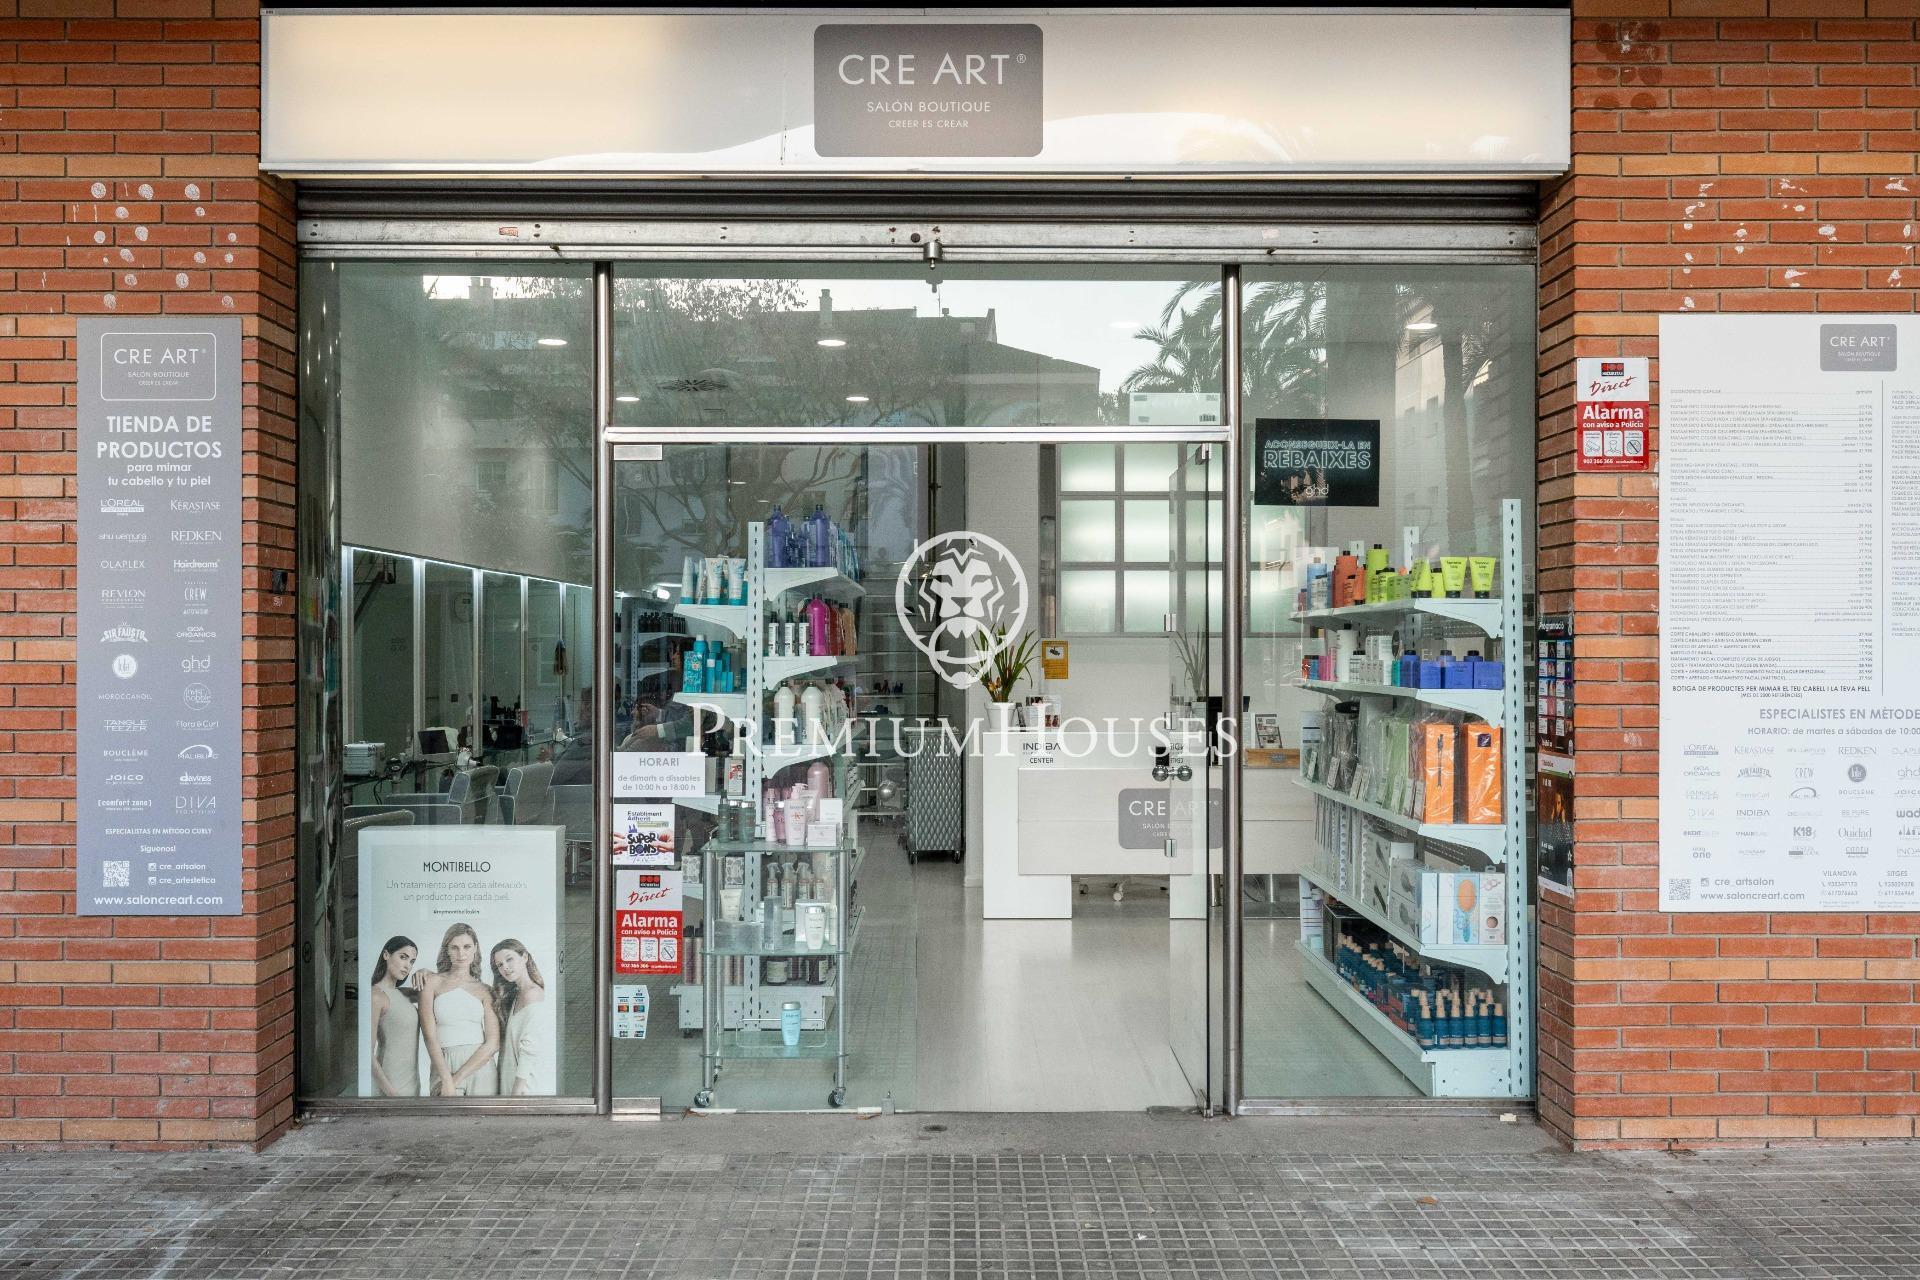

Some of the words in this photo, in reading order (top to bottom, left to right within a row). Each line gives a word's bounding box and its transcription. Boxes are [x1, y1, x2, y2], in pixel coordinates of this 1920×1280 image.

[838, 54, 915, 86] CRE
[867, 99, 913, 112] SALÓN
[919, 101, 991, 113] BOUTIQUE
[888, 120, 919, 128] CREER
[922, 120, 933, 128] ES
[936, 120, 969, 128] CREAR
[1830, 336, 1856, 347] CRE
[113, 348, 152, 364] CRE
[1589, 376, 1637, 397] Direct
[1583, 405, 1644, 420] Alarma
[107, 416, 179, 433] TIENDA
[186, 416, 212, 433] DE
[97, 442, 222, 458] PRODUCTOS
[1358, 441, 1371, 449] EN
[1264, 450, 1371, 469] REBAIXES
[127, 464, 153, 473] para
[156, 463, 192, 472] mimar
[108, 477, 118, 486] tu
[121, 476, 164, 486] cabello
[167, 479, 173, 487] y
[177, 477, 187, 486] tu
[190, 476, 211, 487] piel
[171, 531, 222, 541] REDKEN
[100, 560, 145, 569] OLAPLEX
[101, 589, 146, 598] REVLON
[184, 588, 207, 600] CREW
[181, 655, 211, 672] ghd
[1759, 708, 1846, 720] ESPECIALISTES
[1850, 709, 1866, 719] EN
[1792, 727, 1804, 735] de
[1846, 726, 1882, 735] sábados
[1885, 727, 1897, 735] de
[1022, 743, 1061, 751] INDIBA
[1838, 746, 1877, 755] REDKEN
[639, 758, 679, 767] HORARI
[665, 774, 701, 782] dissabtes
[622, 783, 632, 791] de
[635, 783, 654, 791] 10:00
[656, 783, 660, 791] h
[691, 783, 696, 791] h
[175, 795, 216, 809] DIVA
[1129, 801, 1166, 816] CRE
[1793, 826, 1813, 837] K18
[629, 844, 657, 855] BONS
[423, 861, 491, 873] MONTIBELLO
[386, 880, 399, 889] Un
[400, 880, 447, 889] tratamiento
[449, 882, 466, 891] para
[468, 880, 487, 889] cada
[1714, 878, 1774, 887] cre_artsalon
[94, 895, 223, 905] www.saloncreart.com
[416, 892, 452, 902] producto
[454, 893, 472, 902] para
[474, 892, 493, 901] cada
[628, 888, 672, 905] Direct
[1700, 893, 1805, 901] www.saloncreart.com
[621, 913, 678, 928] Alarma
